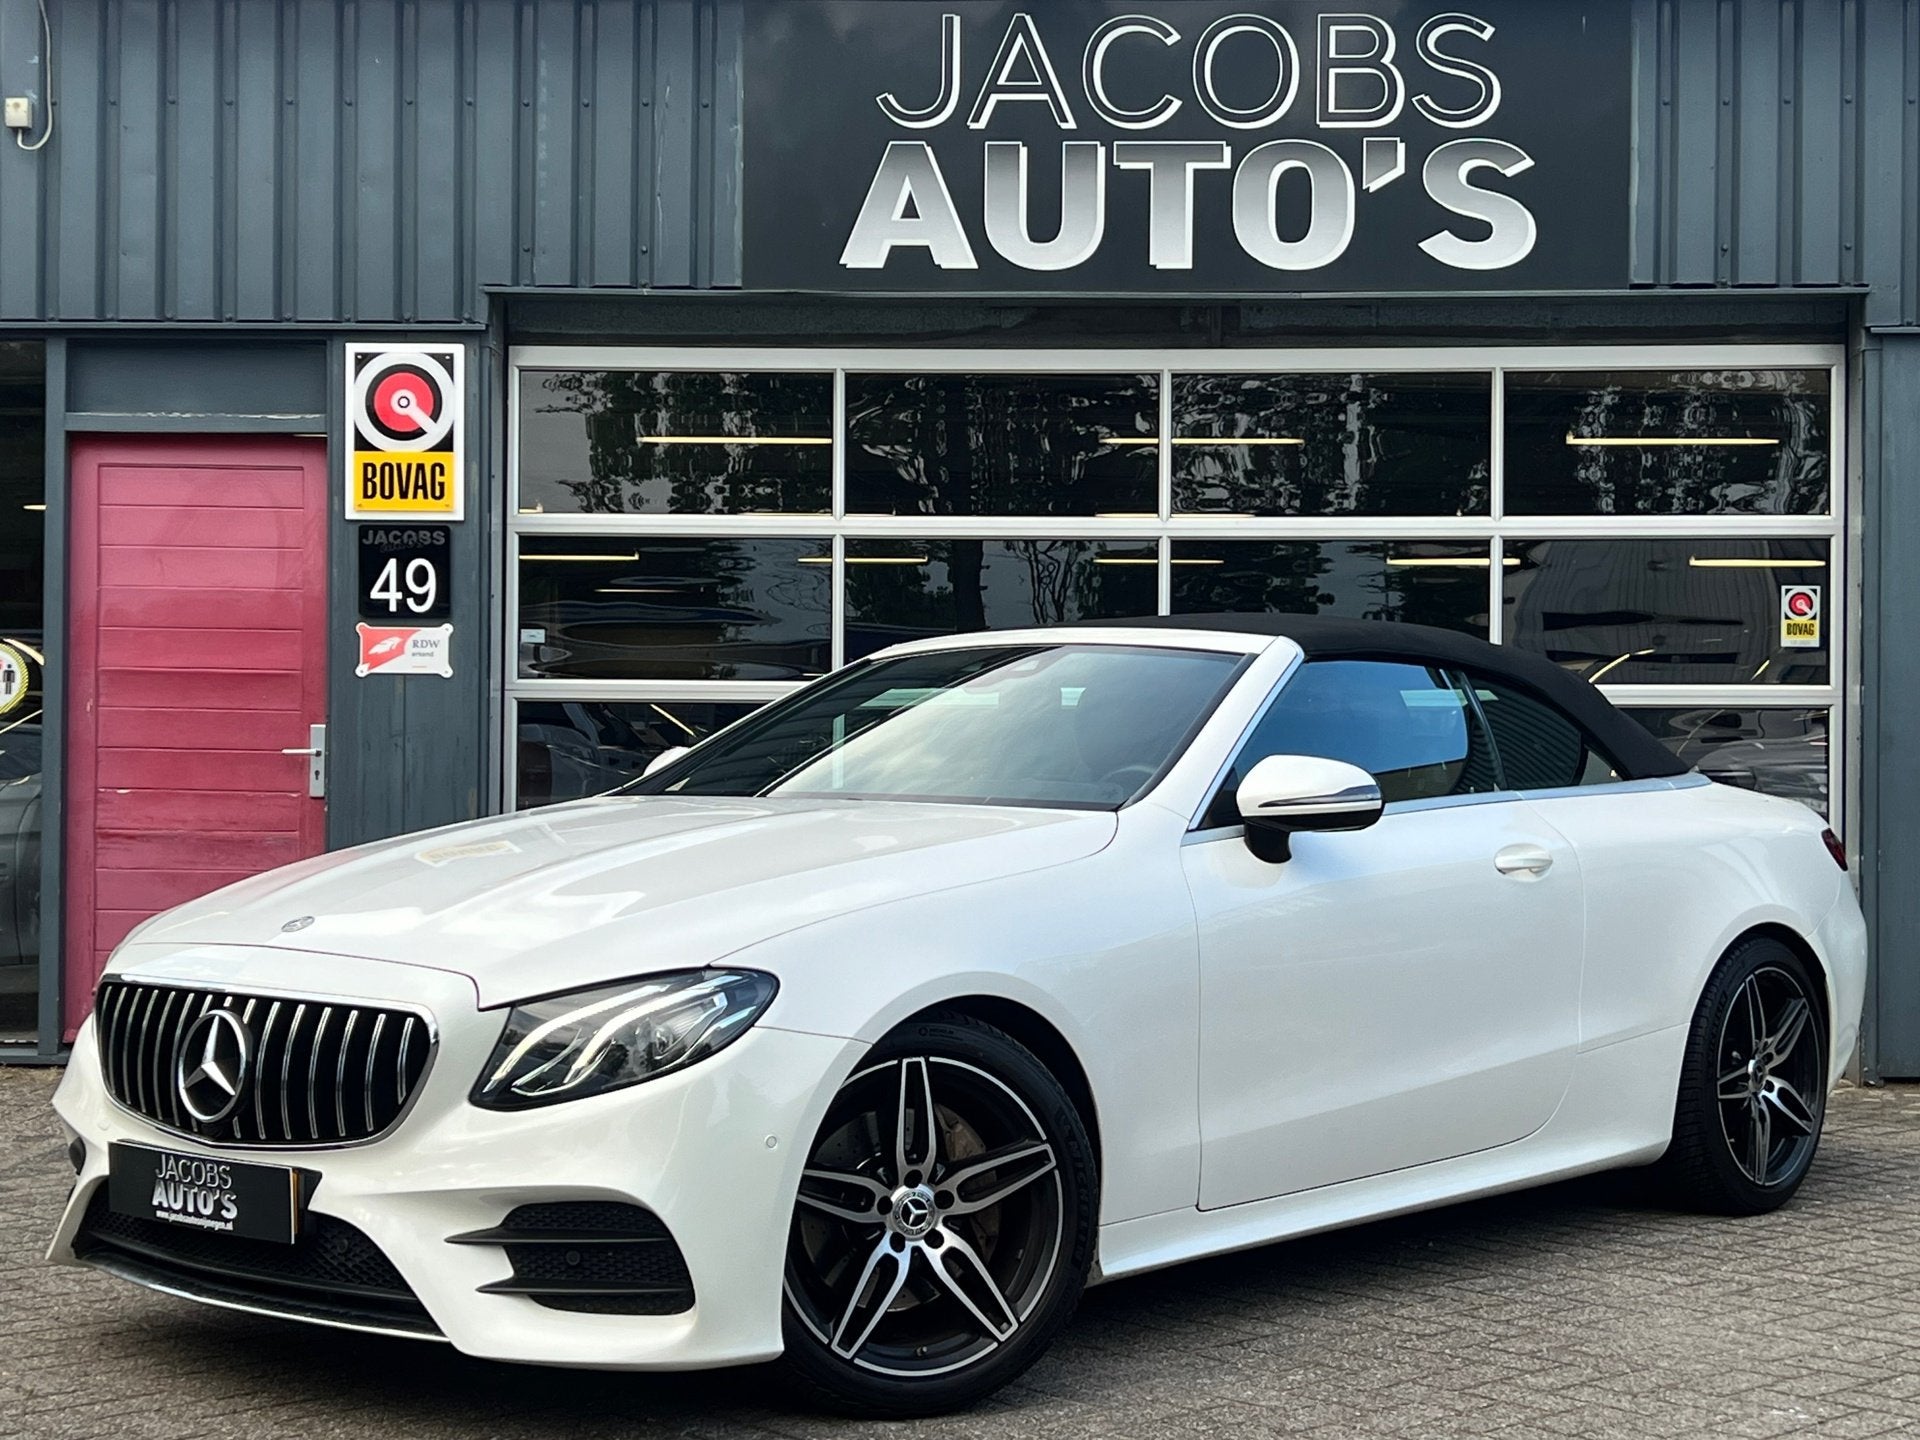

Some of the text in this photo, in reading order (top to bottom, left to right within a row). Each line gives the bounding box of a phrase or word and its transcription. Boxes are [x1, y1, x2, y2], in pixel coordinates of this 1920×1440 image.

[875, 12, 1502, 130] JACOBS
[839, 137, 1537, 271] AUTO'S
[362, 462, 446, 501] BOVAG
[362, 530, 446, 546] JACOBS
[370, 558, 437, 613] 49
[412, 639, 440, 649] RDW
[1786, 622, 1815, 636] BOVAG
[155, 1154, 232, 1189] JACOBS
[152, 1180, 238, 1219] AUTO'S
